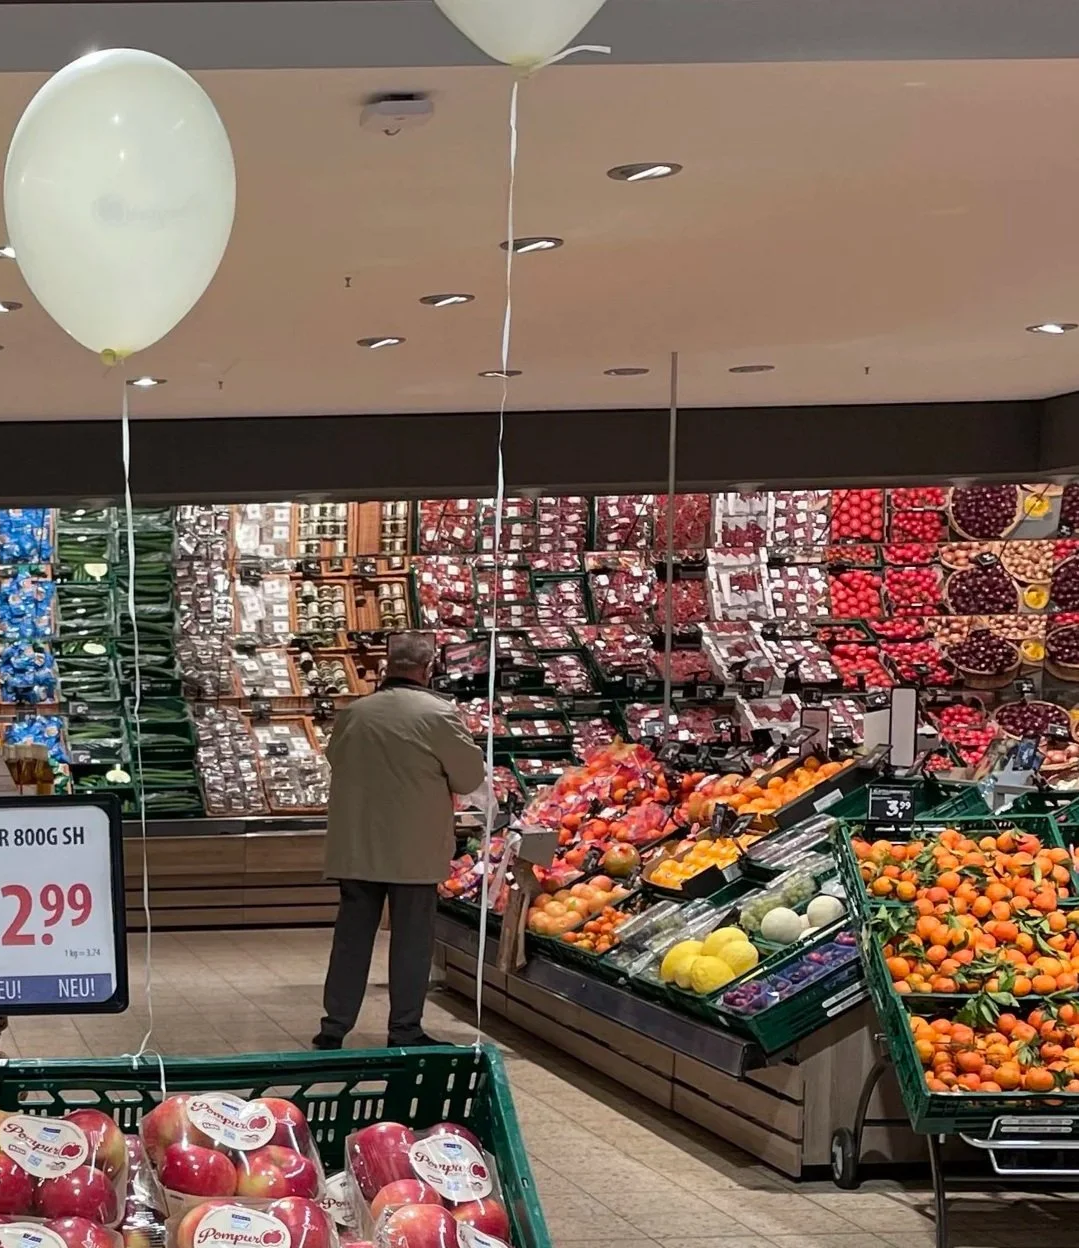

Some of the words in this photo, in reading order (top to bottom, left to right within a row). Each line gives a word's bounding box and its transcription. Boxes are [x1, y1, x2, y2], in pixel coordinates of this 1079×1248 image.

[14, 827, 58, 847] 800G
[63, 826, 85, 844] SH
[58, 978, 95, 997] NEU!
[190, 1101, 248, 1130] Pompur
[3, 1123, 60, 1155] Pompur
[197, 1227, 261, 1245] Pompur
